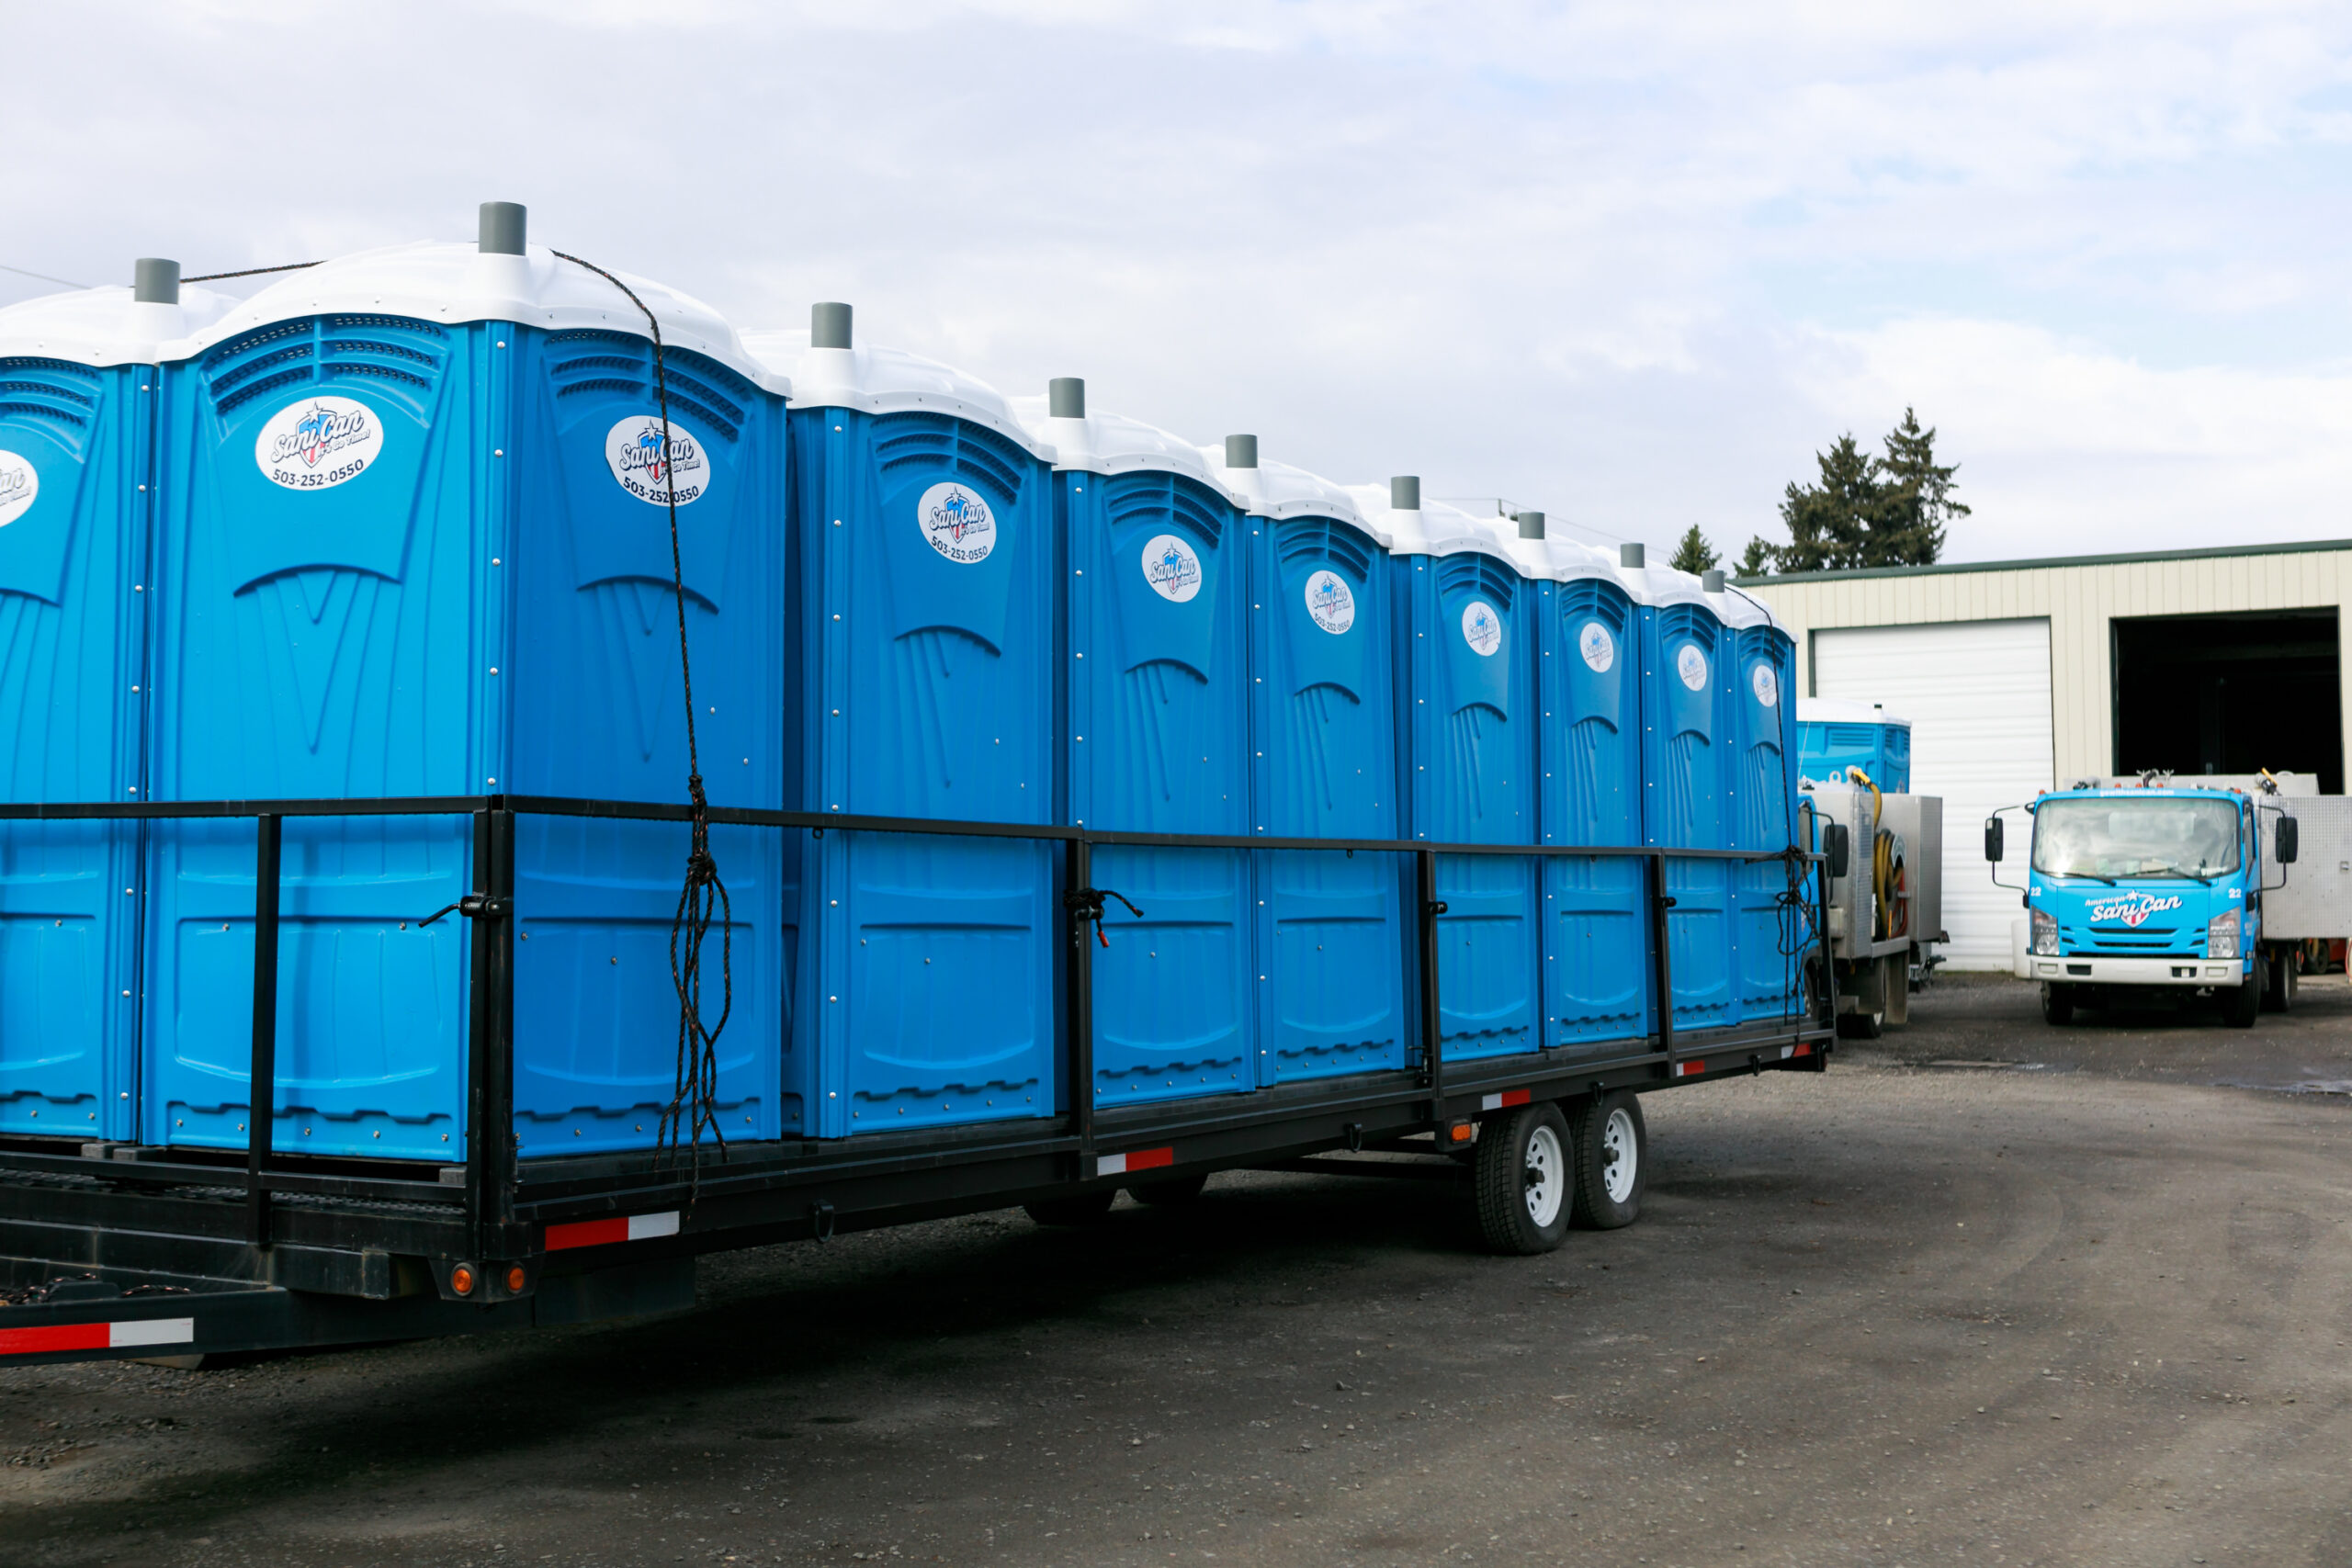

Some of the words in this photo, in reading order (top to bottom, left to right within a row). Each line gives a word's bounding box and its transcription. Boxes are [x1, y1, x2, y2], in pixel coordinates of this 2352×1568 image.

[270, 427, 320, 464] Sani
[319, 410, 365, 443] Can
[619, 443, 660, 471] Sani
[272, 458, 365, 487] 503-252-0550
[623, 476, 699, 503] 503-2520550
[929, 506, 961, 531] Sani
[961, 502, 987, 525] Can
[931, 535, 989, 560] 503-252-0550
[1176, 557, 1196, 579] Can
[2030, 886, 2041, 897] 22
[2085, 895, 2127, 907] American
[2228, 887, 2242, 899] 22
[2090, 903, 2140, 922] Sani
[2140, 895, 2183, 914] Can
